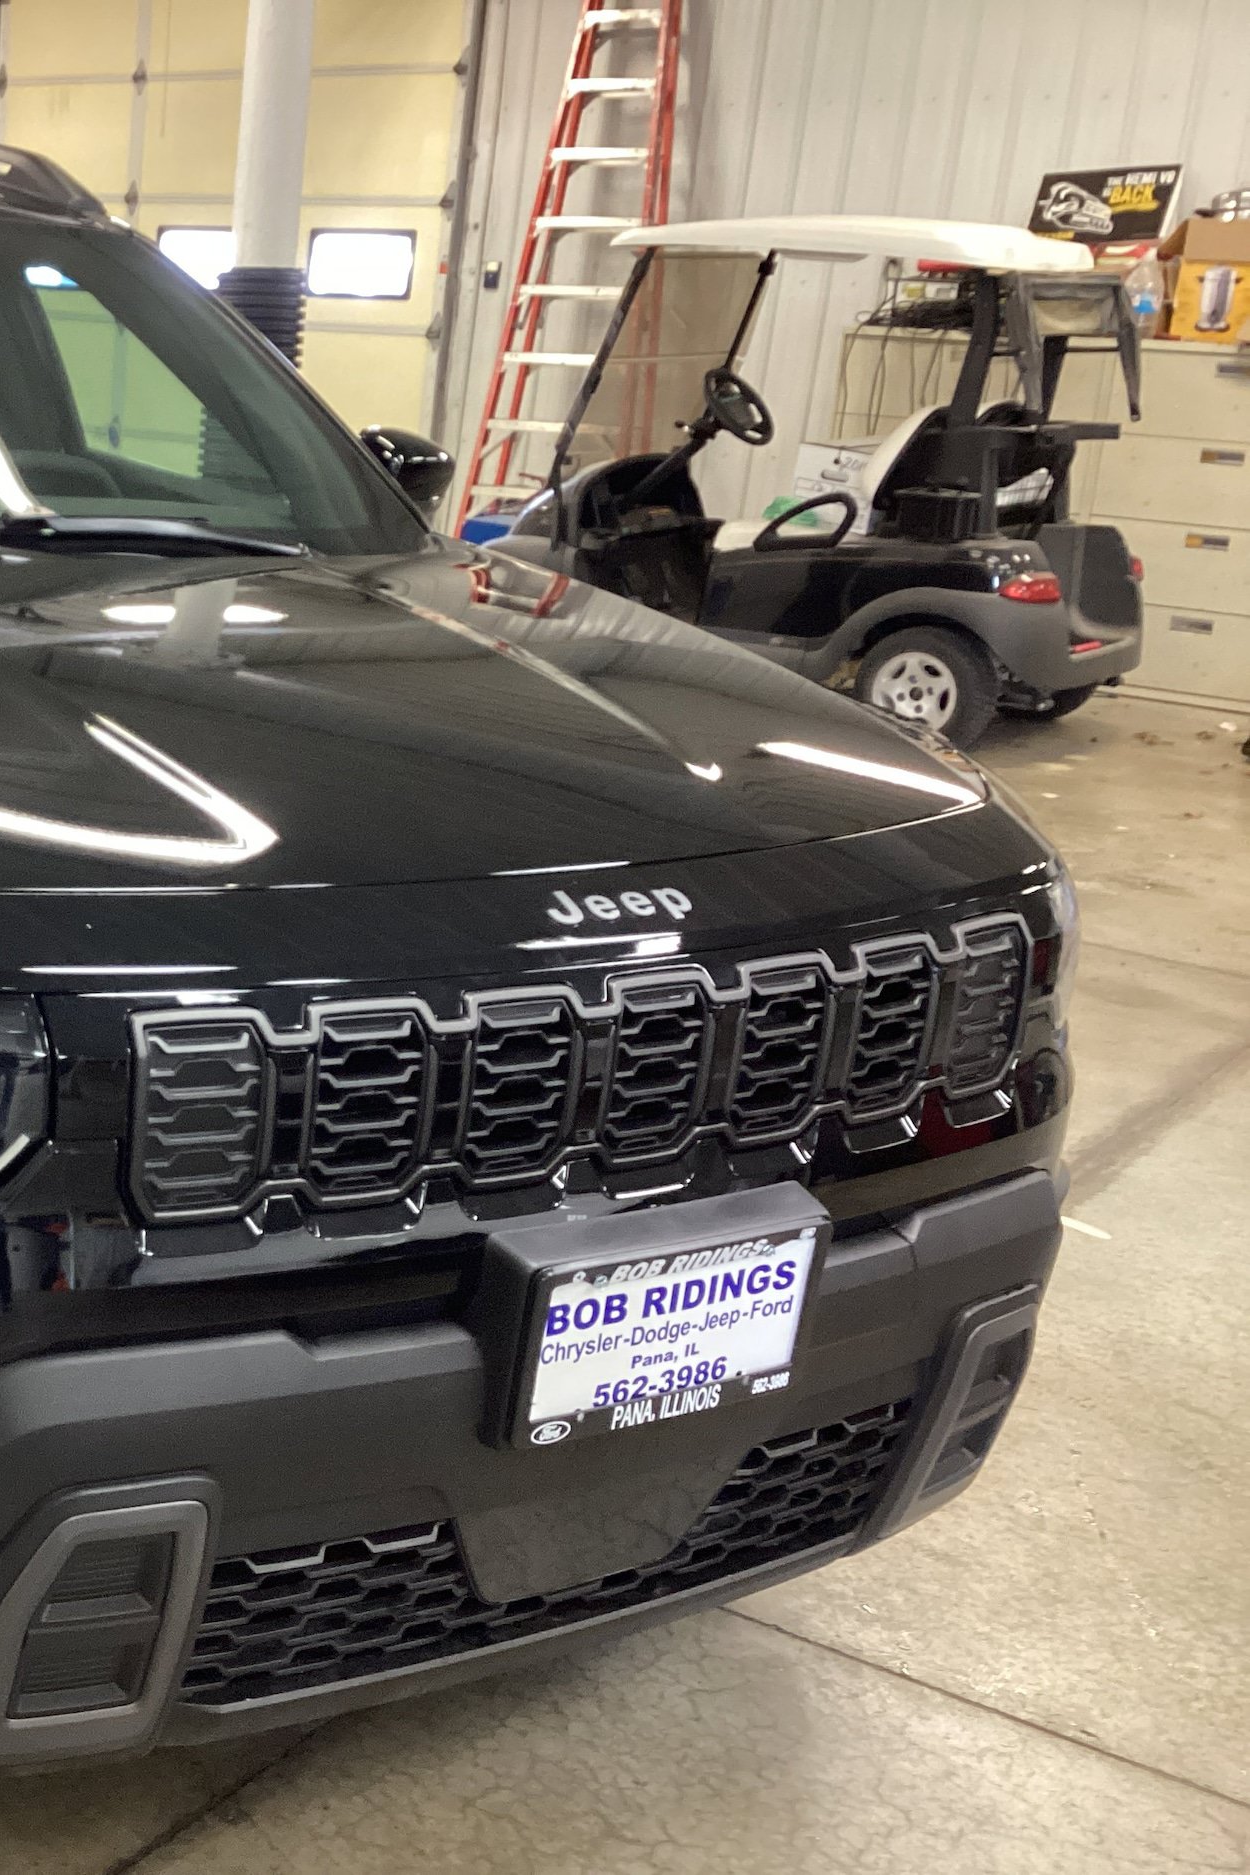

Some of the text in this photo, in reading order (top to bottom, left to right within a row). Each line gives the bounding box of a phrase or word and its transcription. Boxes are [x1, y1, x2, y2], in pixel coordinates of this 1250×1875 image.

[1109, 183, 1156, 204] BACK
[547, 887, 693, 925] Jeep
[609, 1238, 768, 1284] BOB RIDINGS
[545, 1260, 797, 1338] BOB RIDINGS
[539, 1294, 794, 1365] Chrysler-Dodge-Jeep-Ford
[630, 1342, 700, 1369] Pana, IL
[593, 1356, 727, 1408] 562-3986
[658, 1383, 722, 1420] ILLINOIS
